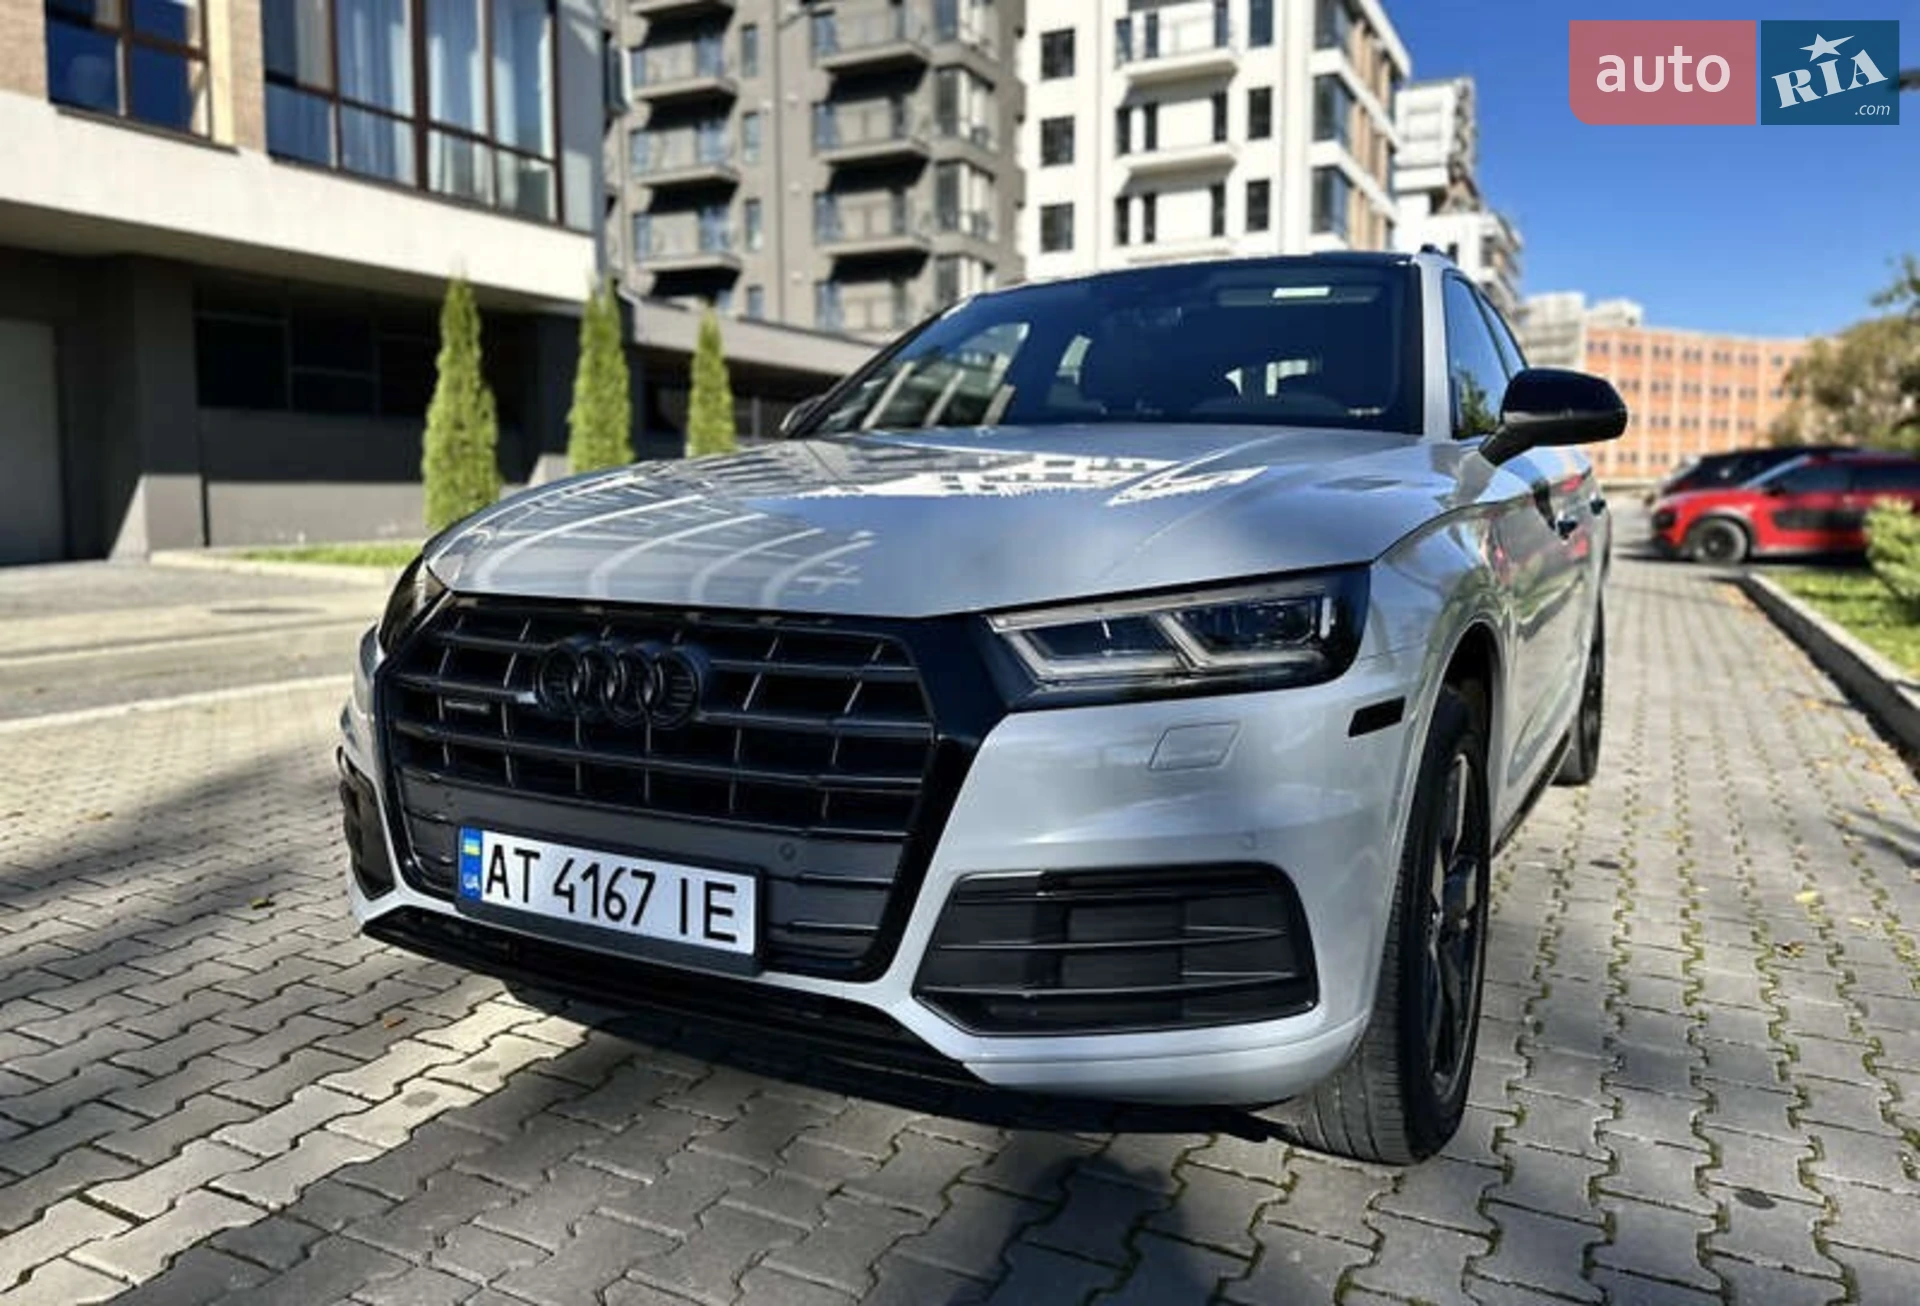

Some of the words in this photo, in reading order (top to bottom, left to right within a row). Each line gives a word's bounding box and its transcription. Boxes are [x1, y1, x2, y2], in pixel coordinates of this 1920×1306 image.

[486, 844, 540, 903] AT
[553, 858, 656, 926] 4167
[680, 878, 737, 944] IE
